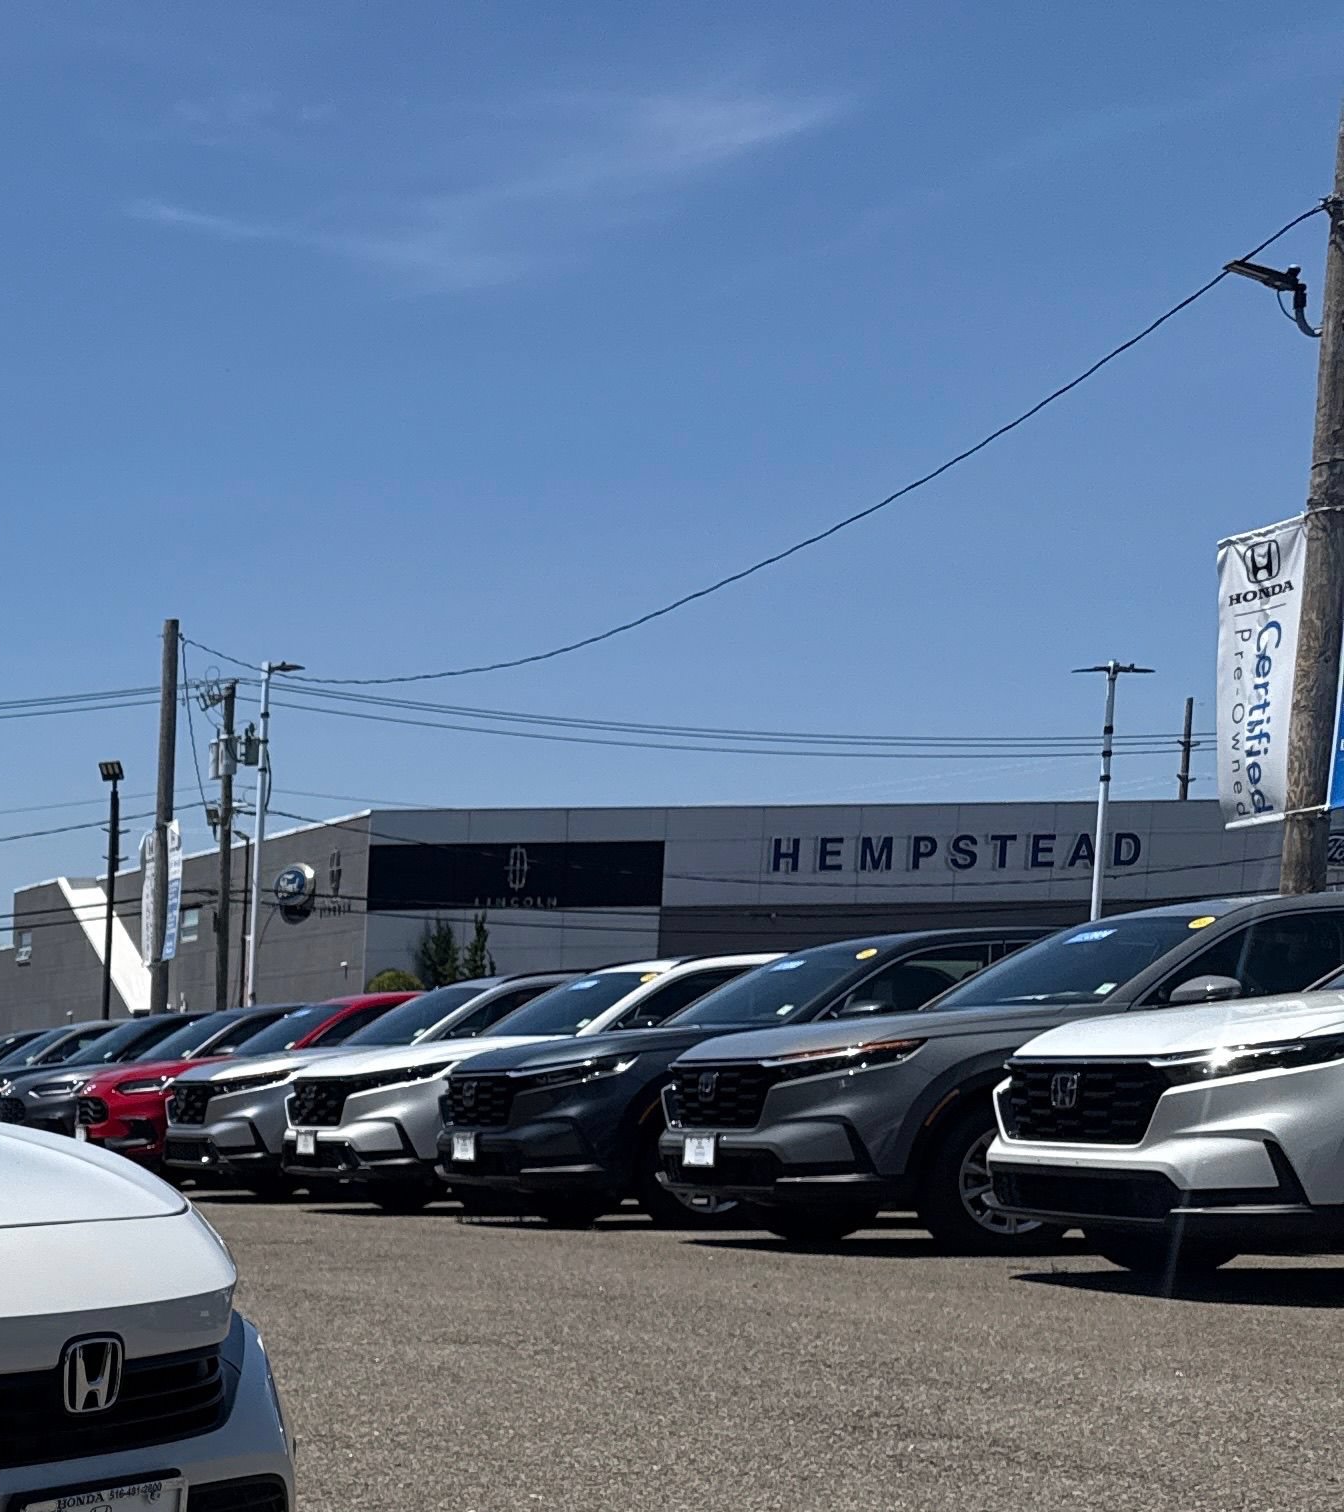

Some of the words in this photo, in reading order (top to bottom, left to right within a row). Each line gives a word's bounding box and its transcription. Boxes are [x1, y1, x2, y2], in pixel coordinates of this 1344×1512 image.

[1228, 580, 1294, 606] HONDA
[1232, 629, 1252, 816] Pre-Owned
[1246, 620, 1282, 814] Certified
[772, 832, 1142, 873] HEMPSTEAD
[57, 1493, 105, 1509] HONDA
